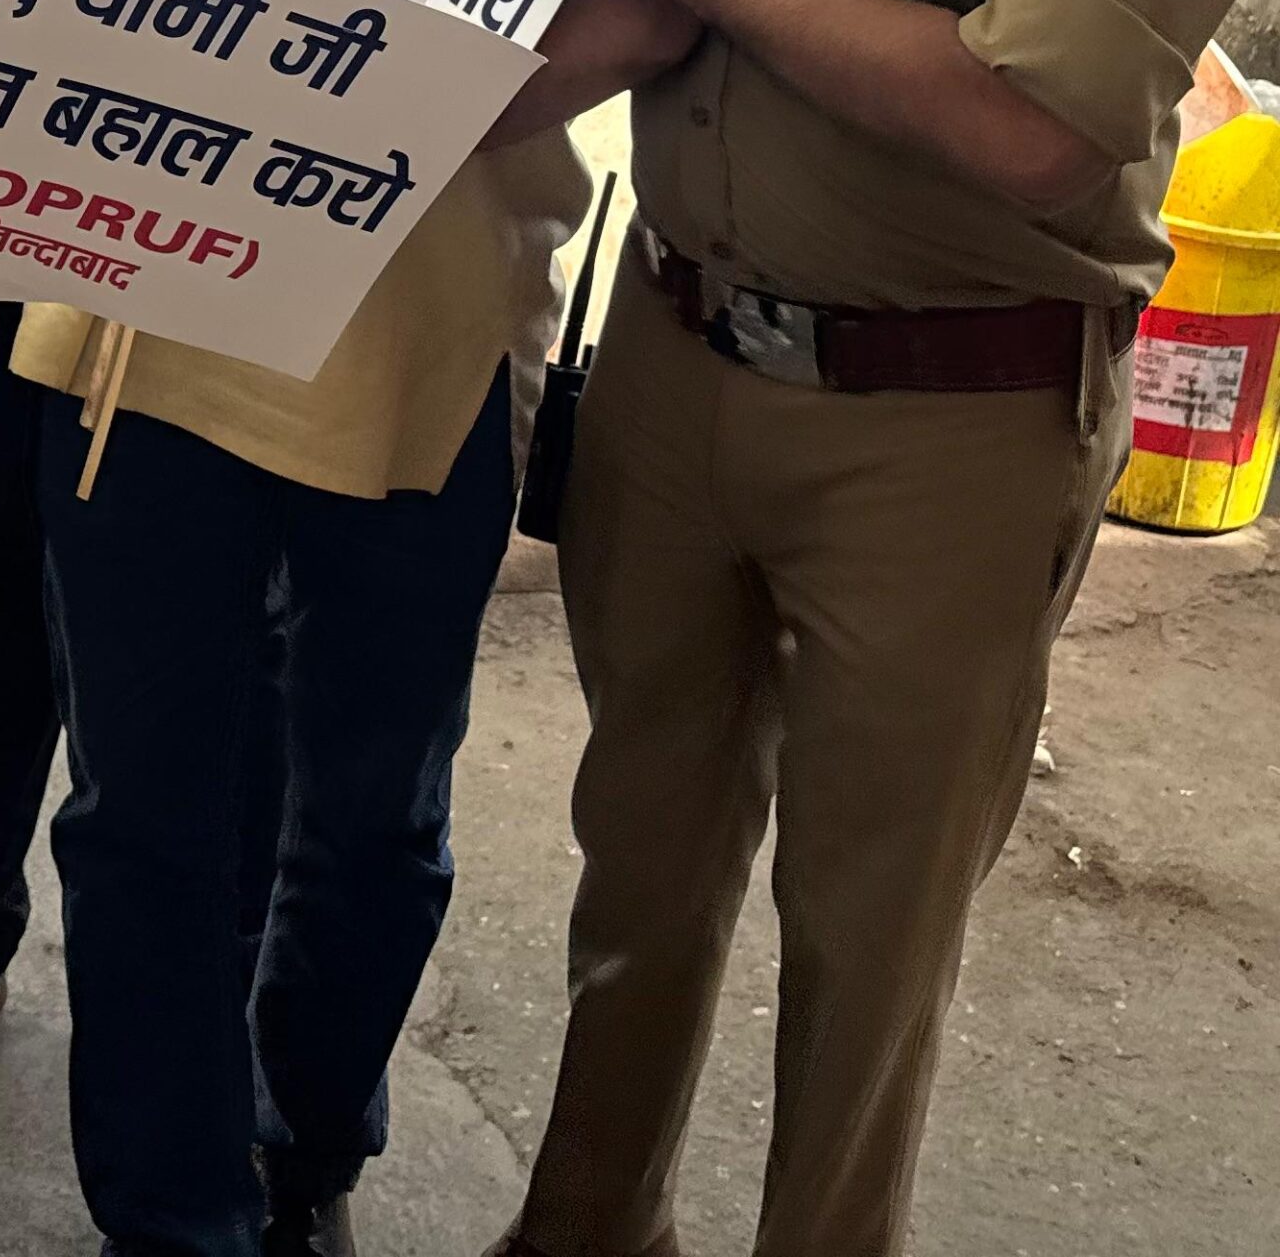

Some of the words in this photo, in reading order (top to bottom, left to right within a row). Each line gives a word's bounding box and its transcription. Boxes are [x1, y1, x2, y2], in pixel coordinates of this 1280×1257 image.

[269, 8, 388, 98] जी
[43, 77, 254, 186] बहाल
[253, 138, 417, 233] करो
